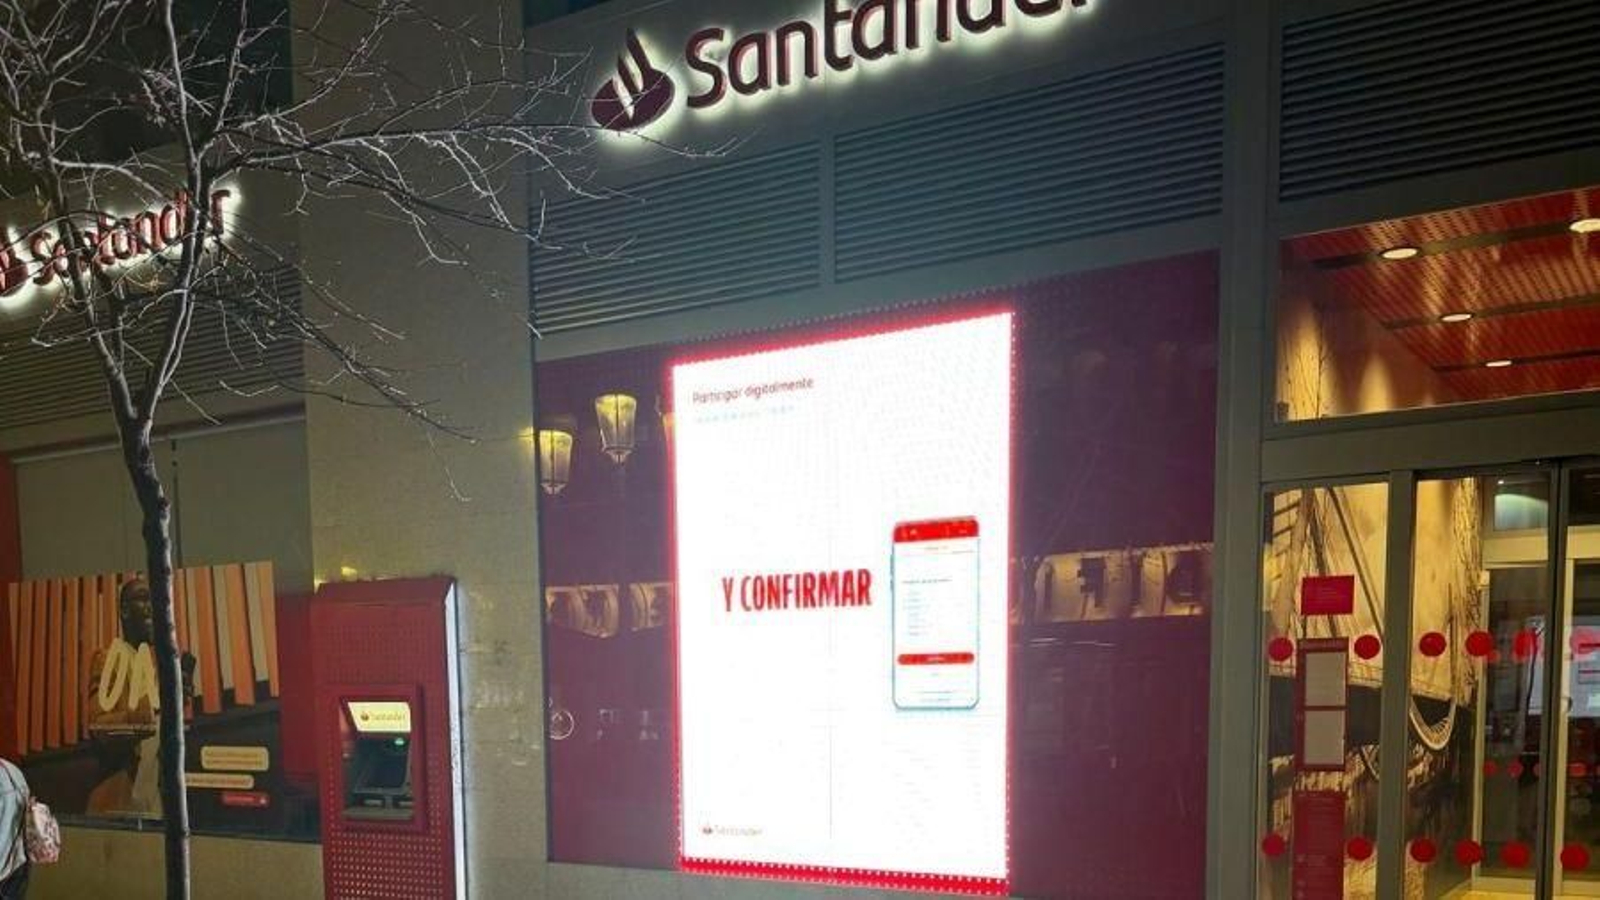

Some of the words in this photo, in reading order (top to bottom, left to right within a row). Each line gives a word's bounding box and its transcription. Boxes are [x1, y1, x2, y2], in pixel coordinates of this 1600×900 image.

[744, 378, 815, 399] digitalmente
[722, 577, 734, 612] Y
[740, 568, 873, 612] CONFIRMAR
